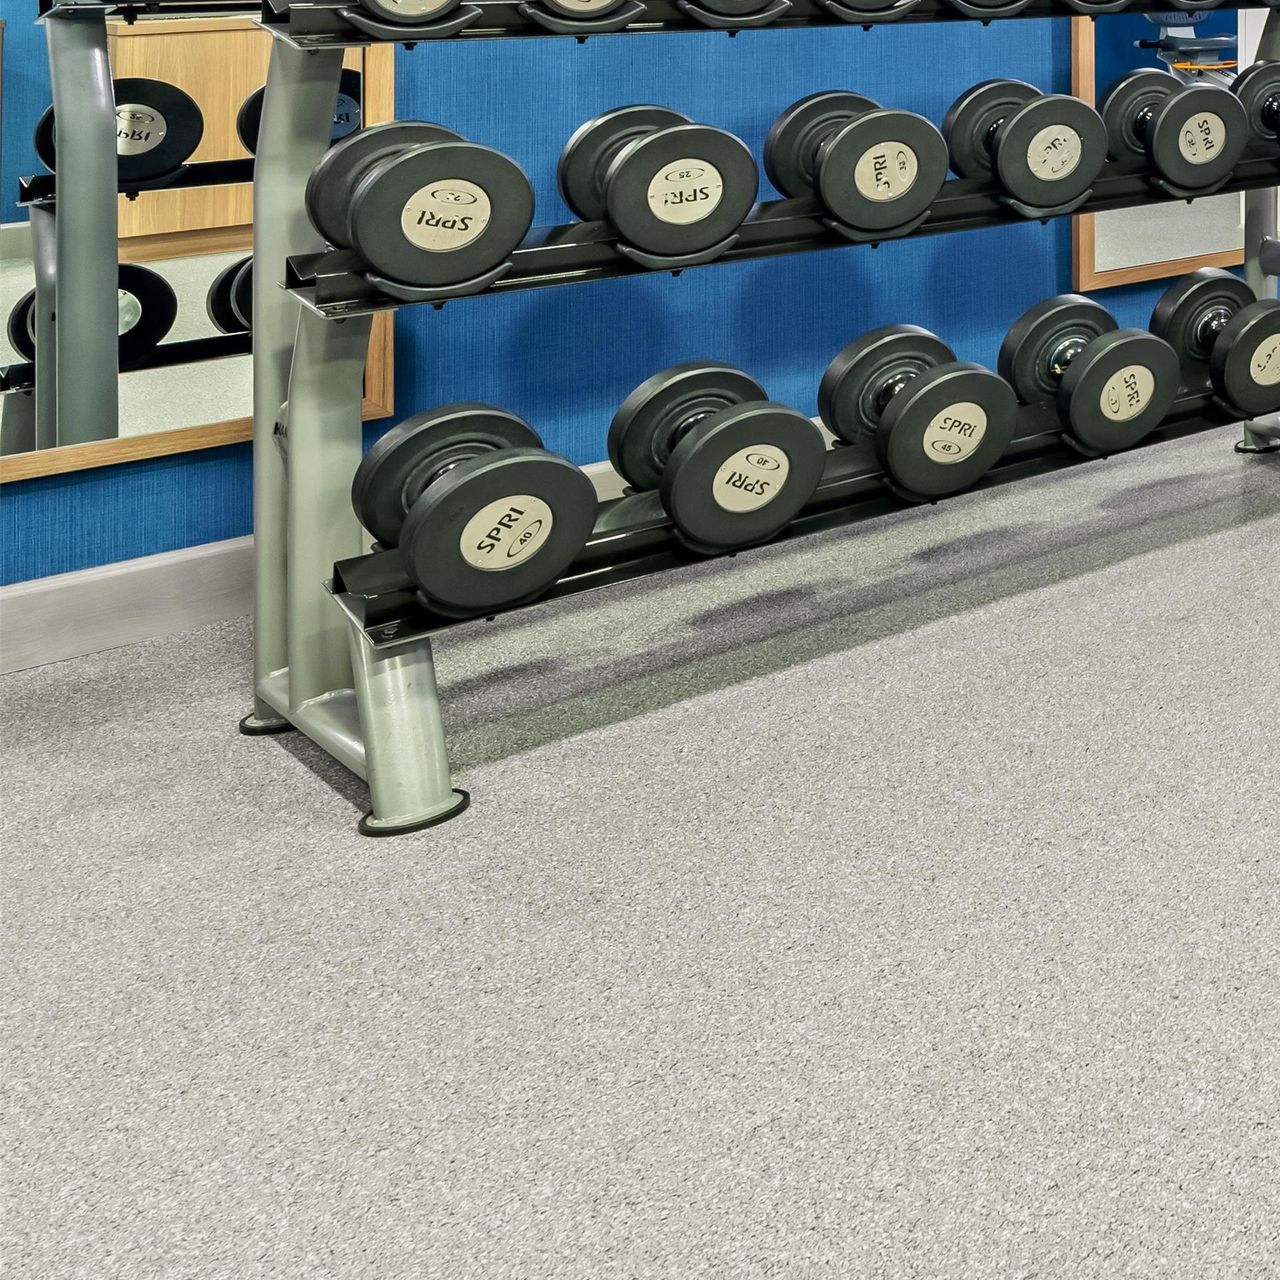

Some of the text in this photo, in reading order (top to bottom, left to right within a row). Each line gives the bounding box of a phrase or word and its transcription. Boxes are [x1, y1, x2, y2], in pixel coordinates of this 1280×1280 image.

[1198, 120, 1214, 150] SPRI
[873, 155, 890, 191] SPRI
[664, 187, 709, 205] SPRI
[416, 210, 473, 231] SPRI
[1124, 374, 1140, 407] SPRI
[939, 417, 977, 438] SPRI
[726, 471, 770, 495] SPRI
[477, 507, 525, 554] SPRI
[520, 532, 532, 545] 40
